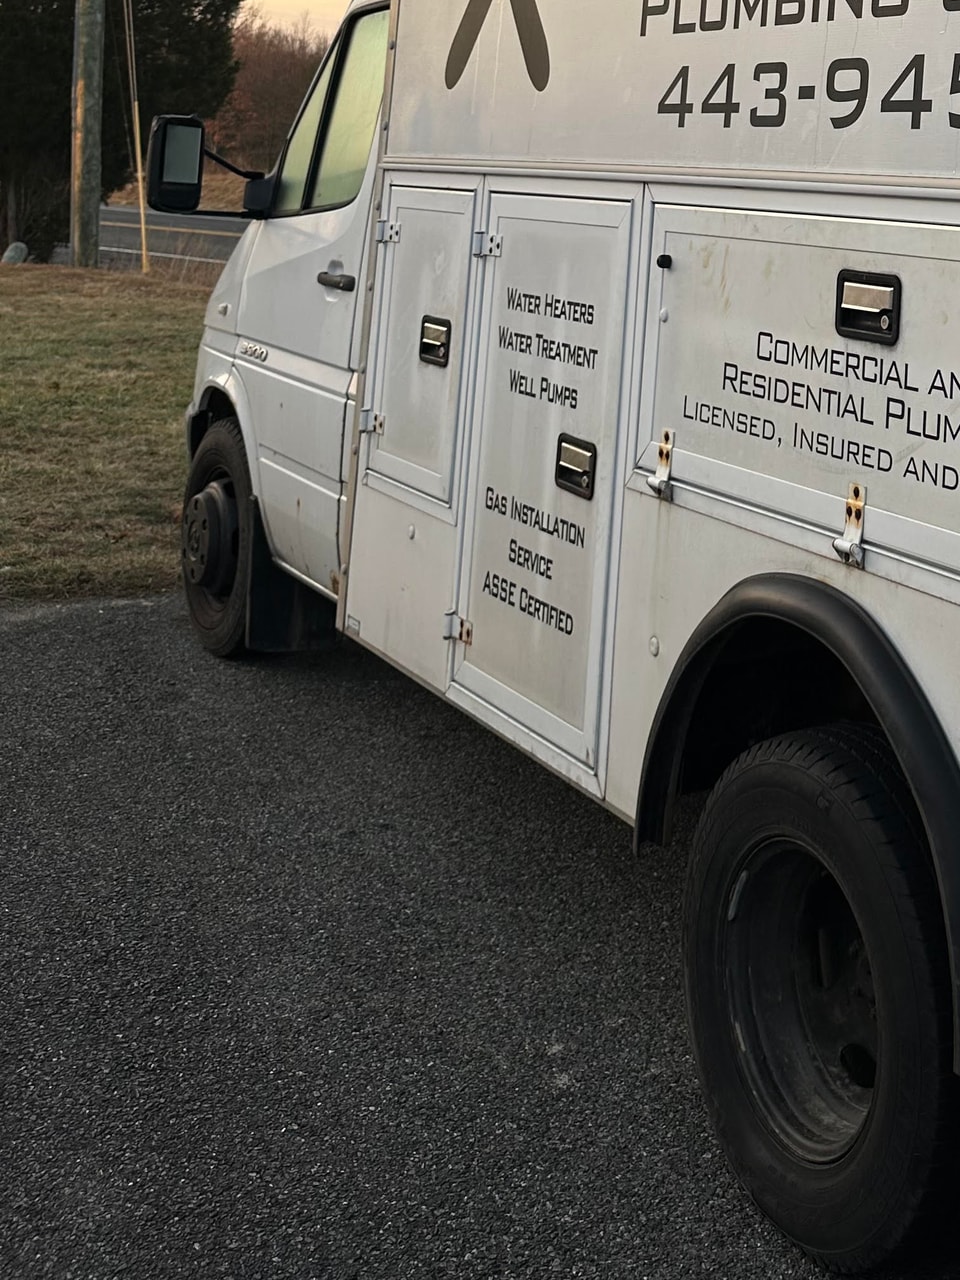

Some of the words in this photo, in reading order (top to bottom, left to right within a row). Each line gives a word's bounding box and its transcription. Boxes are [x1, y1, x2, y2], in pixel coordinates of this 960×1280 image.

[506, 287, 541, 316] WATER
[544, 293, 594, 325] HEATERS
[498, 326, 533, 355] WATER
[535, 333, 598, 370] TREATMENT
[756, 331, 919, 393] COMMERCIAL
[509, 369, 536, 398] WELL
[540, 376, 578, 409] PUMPS
[722, 363, 874, 427] RESIDENTIAL
[682, 395, 782, 448] LICENSED,
[793, 421, 893, 474] INSURED
[903, 456, 959, 491] AND
[485, 486, 507, 515] GAS
[510, 495, 585, 549] INSTALLATION
[508, 539, 553, 580] SERVICE
[482, 571, 515, 606] ASSE
[519, 587, 574, 636] CERTIFIED
